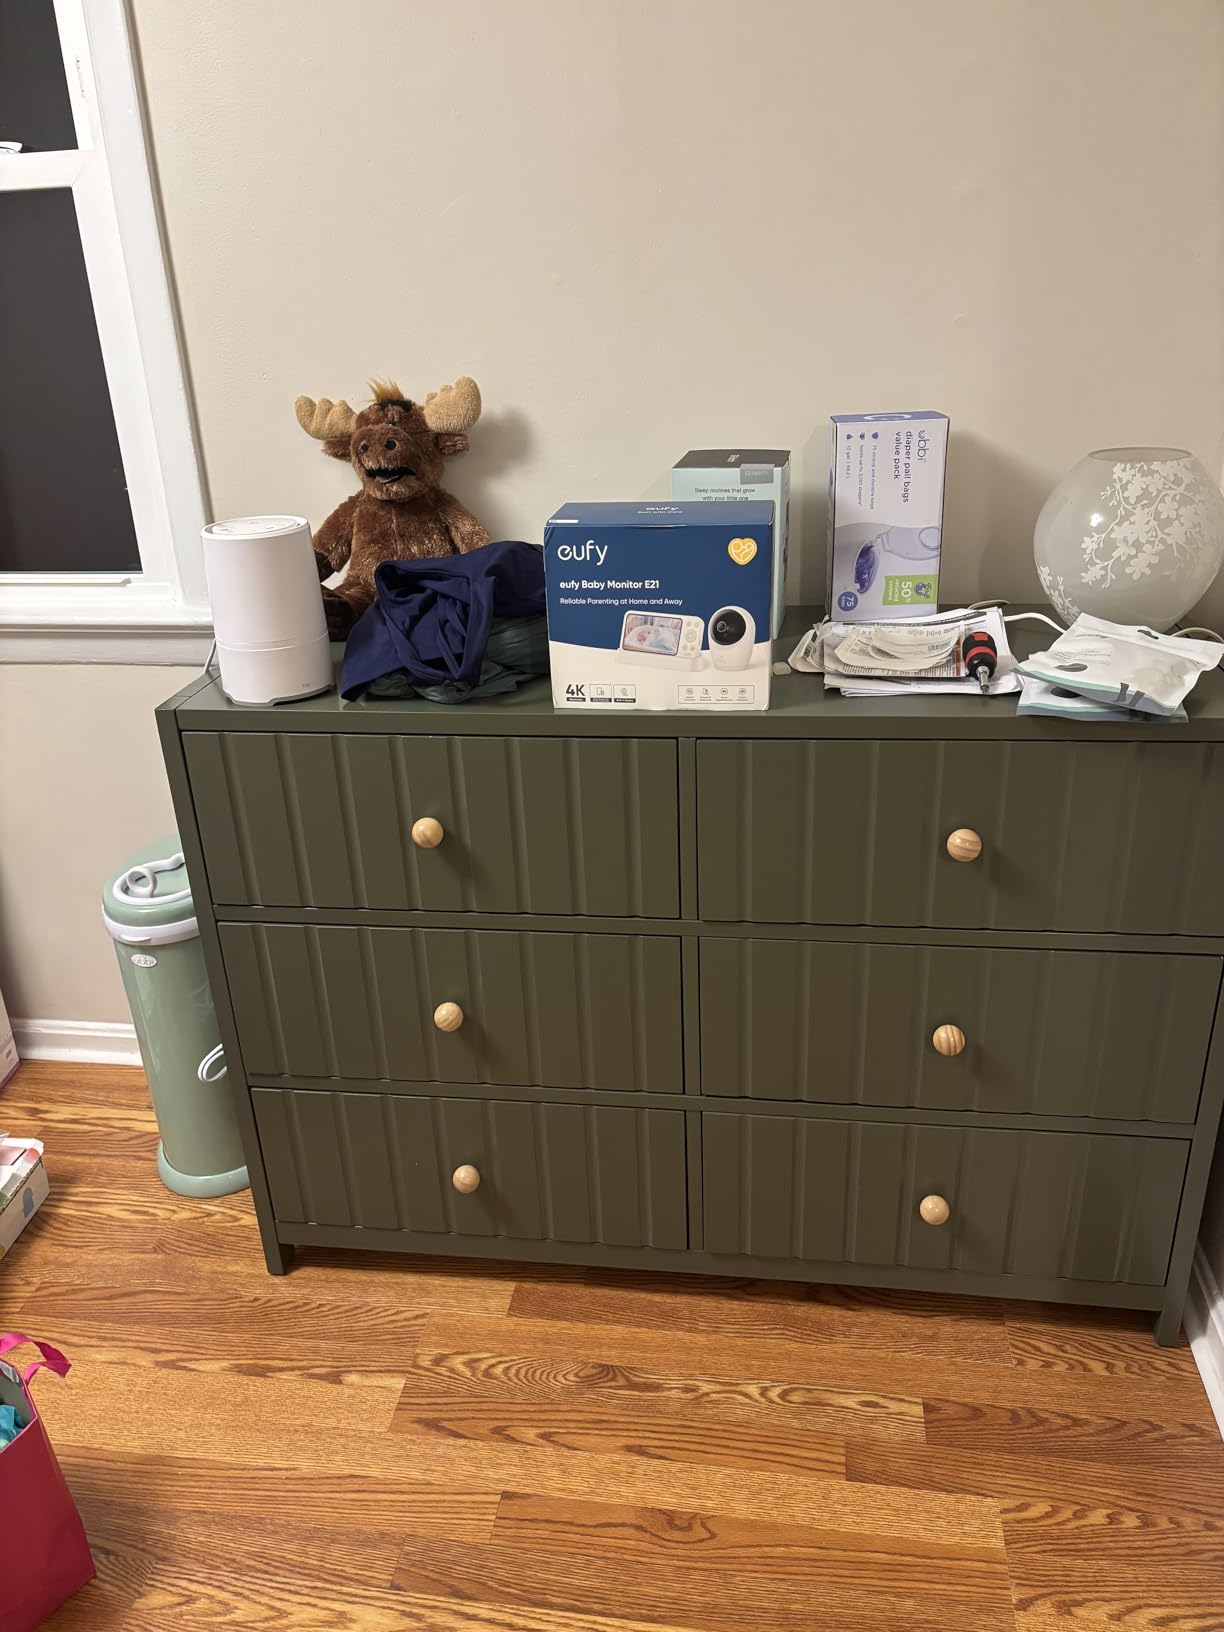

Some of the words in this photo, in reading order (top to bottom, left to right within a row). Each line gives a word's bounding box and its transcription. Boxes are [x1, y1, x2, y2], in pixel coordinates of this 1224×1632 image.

[894, 431, 902, 456] value
[904, 430, 913, 460] diaper
[893, 458, 901, 480] pack
[904, 462, 912, 479] pail
[902, 481, 911, 503] bags
[557, 539, 608, 566] eufy
[559, 580, 580, 590] eufy
[581, 580, 605, 591] Baby
[607, 580, 643, 589] Monitor
[644, 580, 660, 589] E21
[559, 597, 586, 605] Reliable
[587, 597, 619, 606] Parenting
[628, 597, 649, 605] Home
[649, 597, 663, 605] and
[664, 598, 683, 607] Away
[846, 596, 854, 607] 75
[565, 684, 586, 697] 4K
